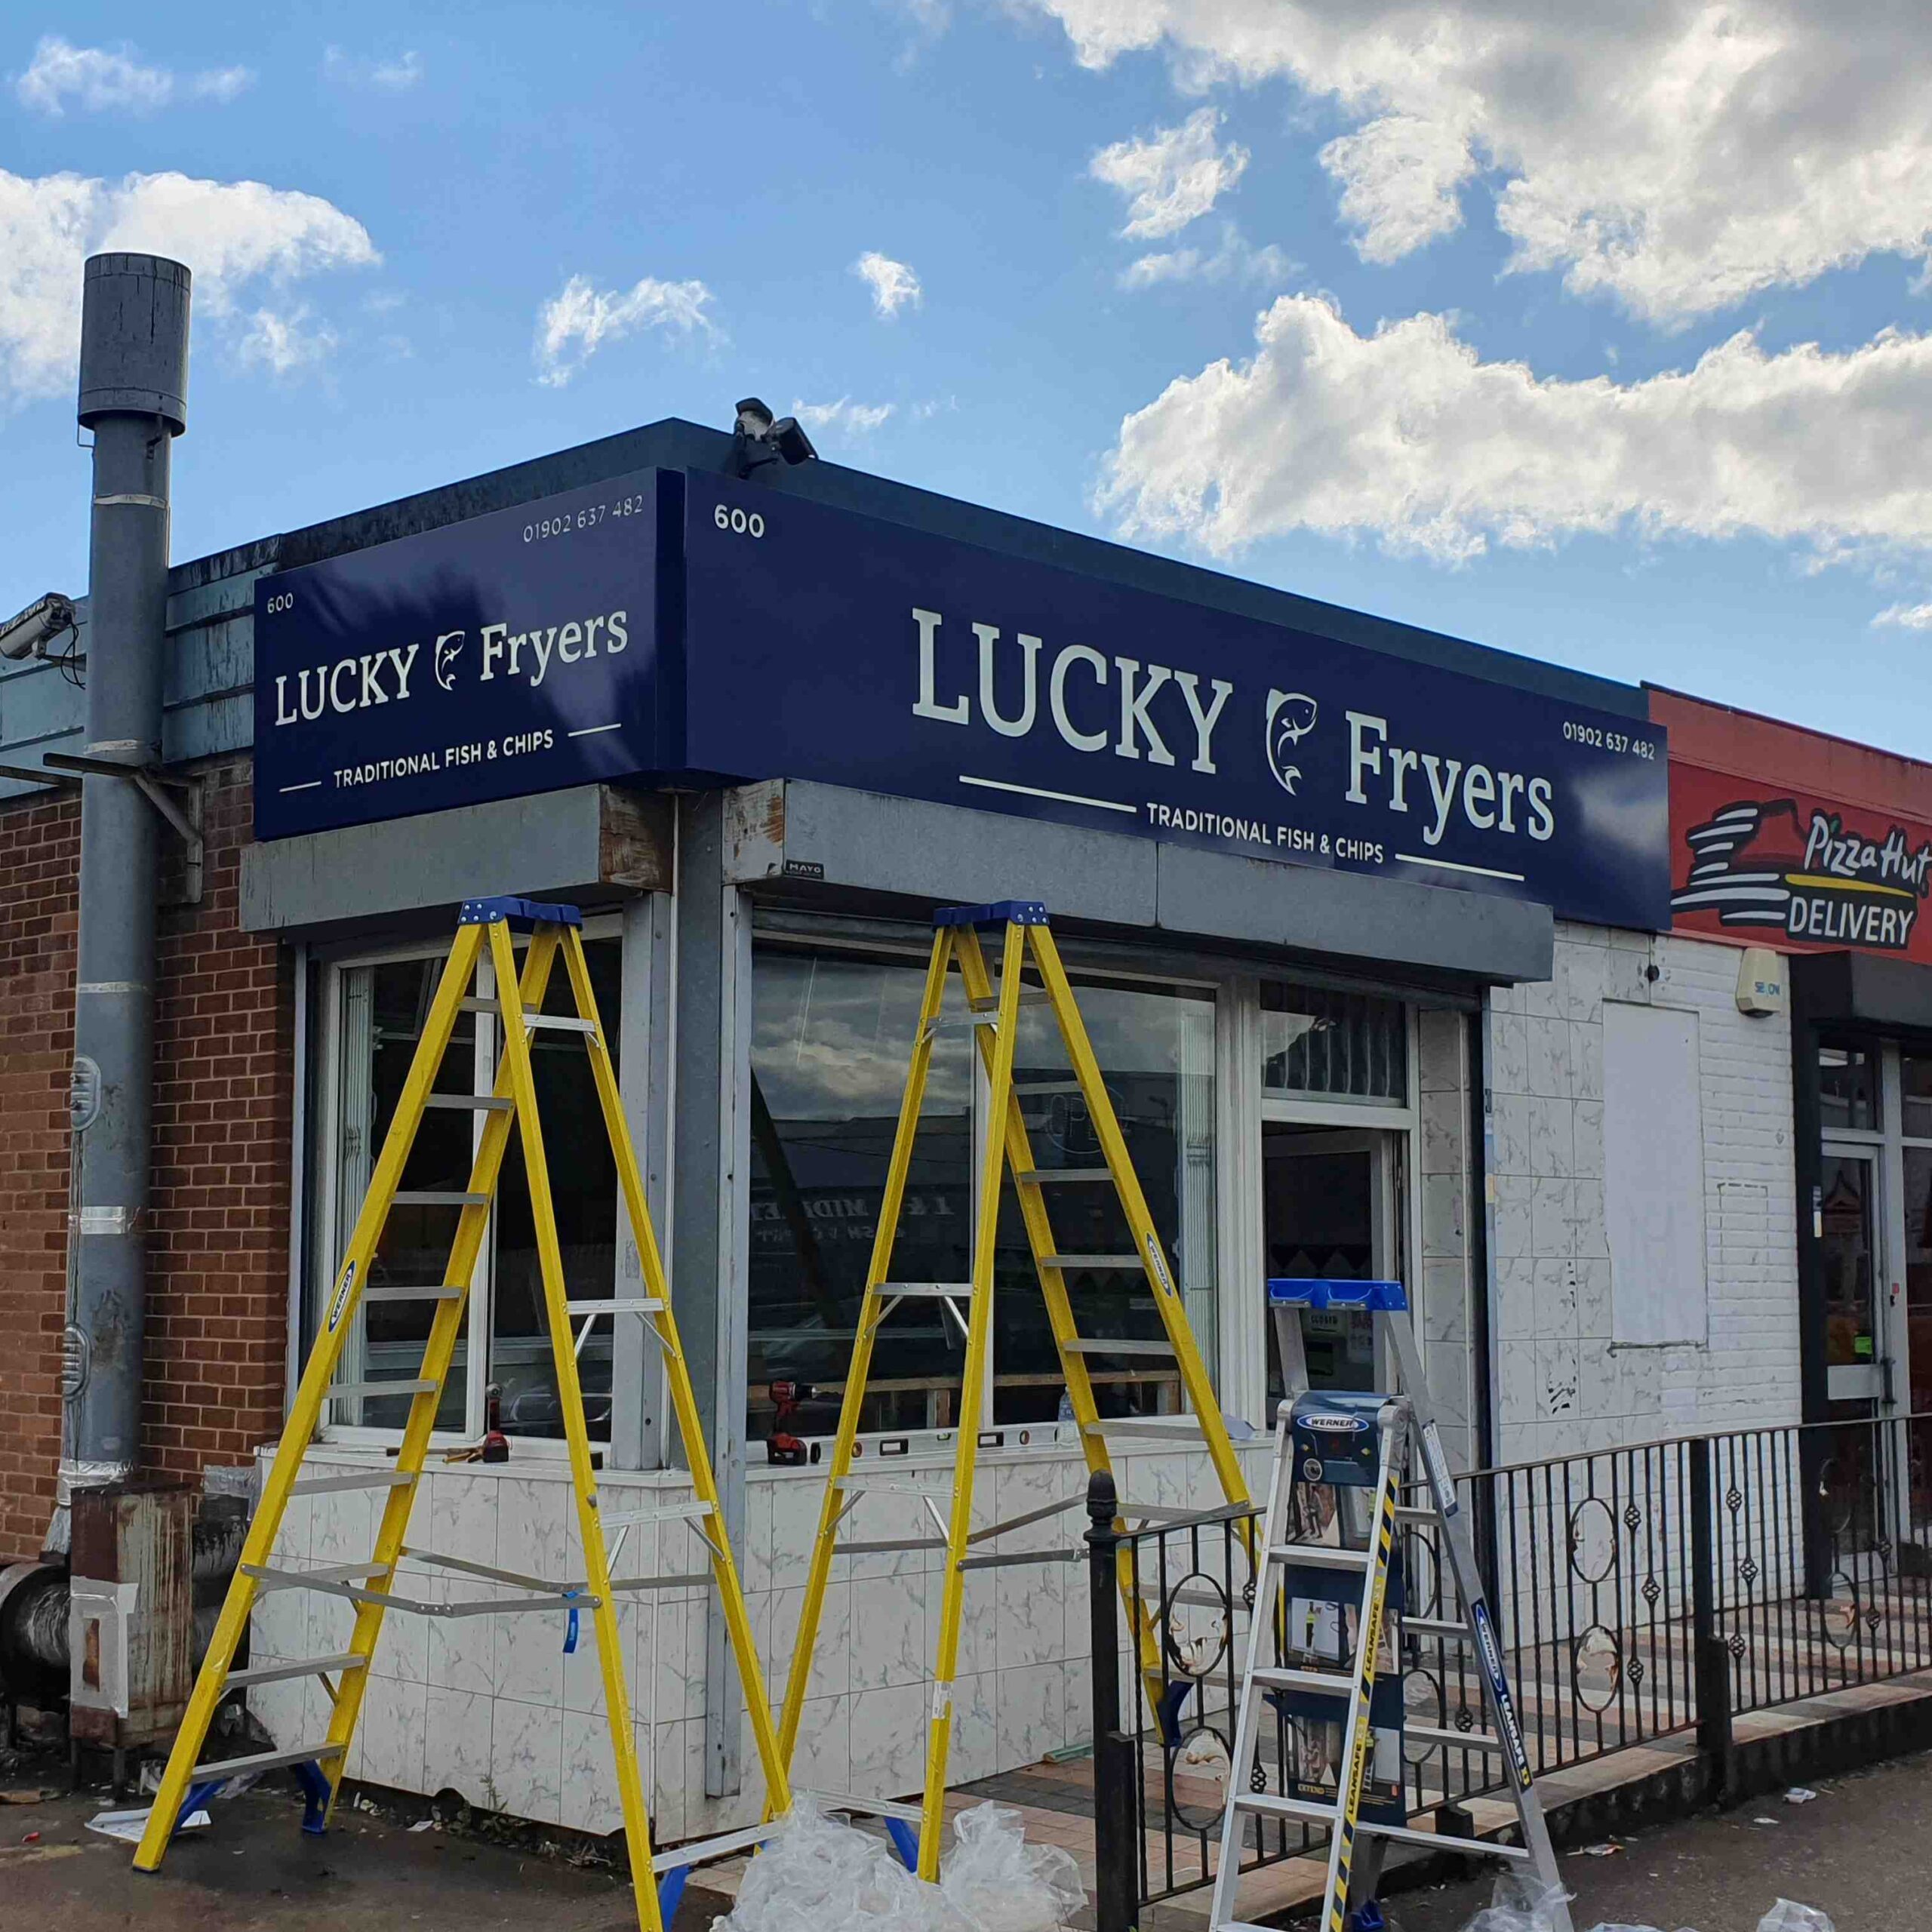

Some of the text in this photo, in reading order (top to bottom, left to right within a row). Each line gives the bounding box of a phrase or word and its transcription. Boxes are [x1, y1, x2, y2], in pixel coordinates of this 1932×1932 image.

[524, 494, 643, 543] 01902 637 482
[714, 504, 765, 538] 600
[267, 592, 294, 614] 600
[275, 610, 628, 726] LUCKY Fryers
[912, 607, 1555, 846] LUCKY Fryers
[1563, 721, 1654, 760] 01902 637 482
[334, 729, 553, 789] TRADITIONAL FISH & CHIPS
[1146, 801, 1384, 864] TRADITIONAL FISH & CHIPS
[1804, 815, 1932, 884] Pizza Hut
[1789, 896, 1914, 944] DELIVERY
[331, 1273, 351, 1318] WERNER
[1311, 1418, 1353, 1427] WERNER
[1365, 1602, 1380, 1673] LEANSAFE
[1348, 1743, 1362, 1815] LEANSAFE
